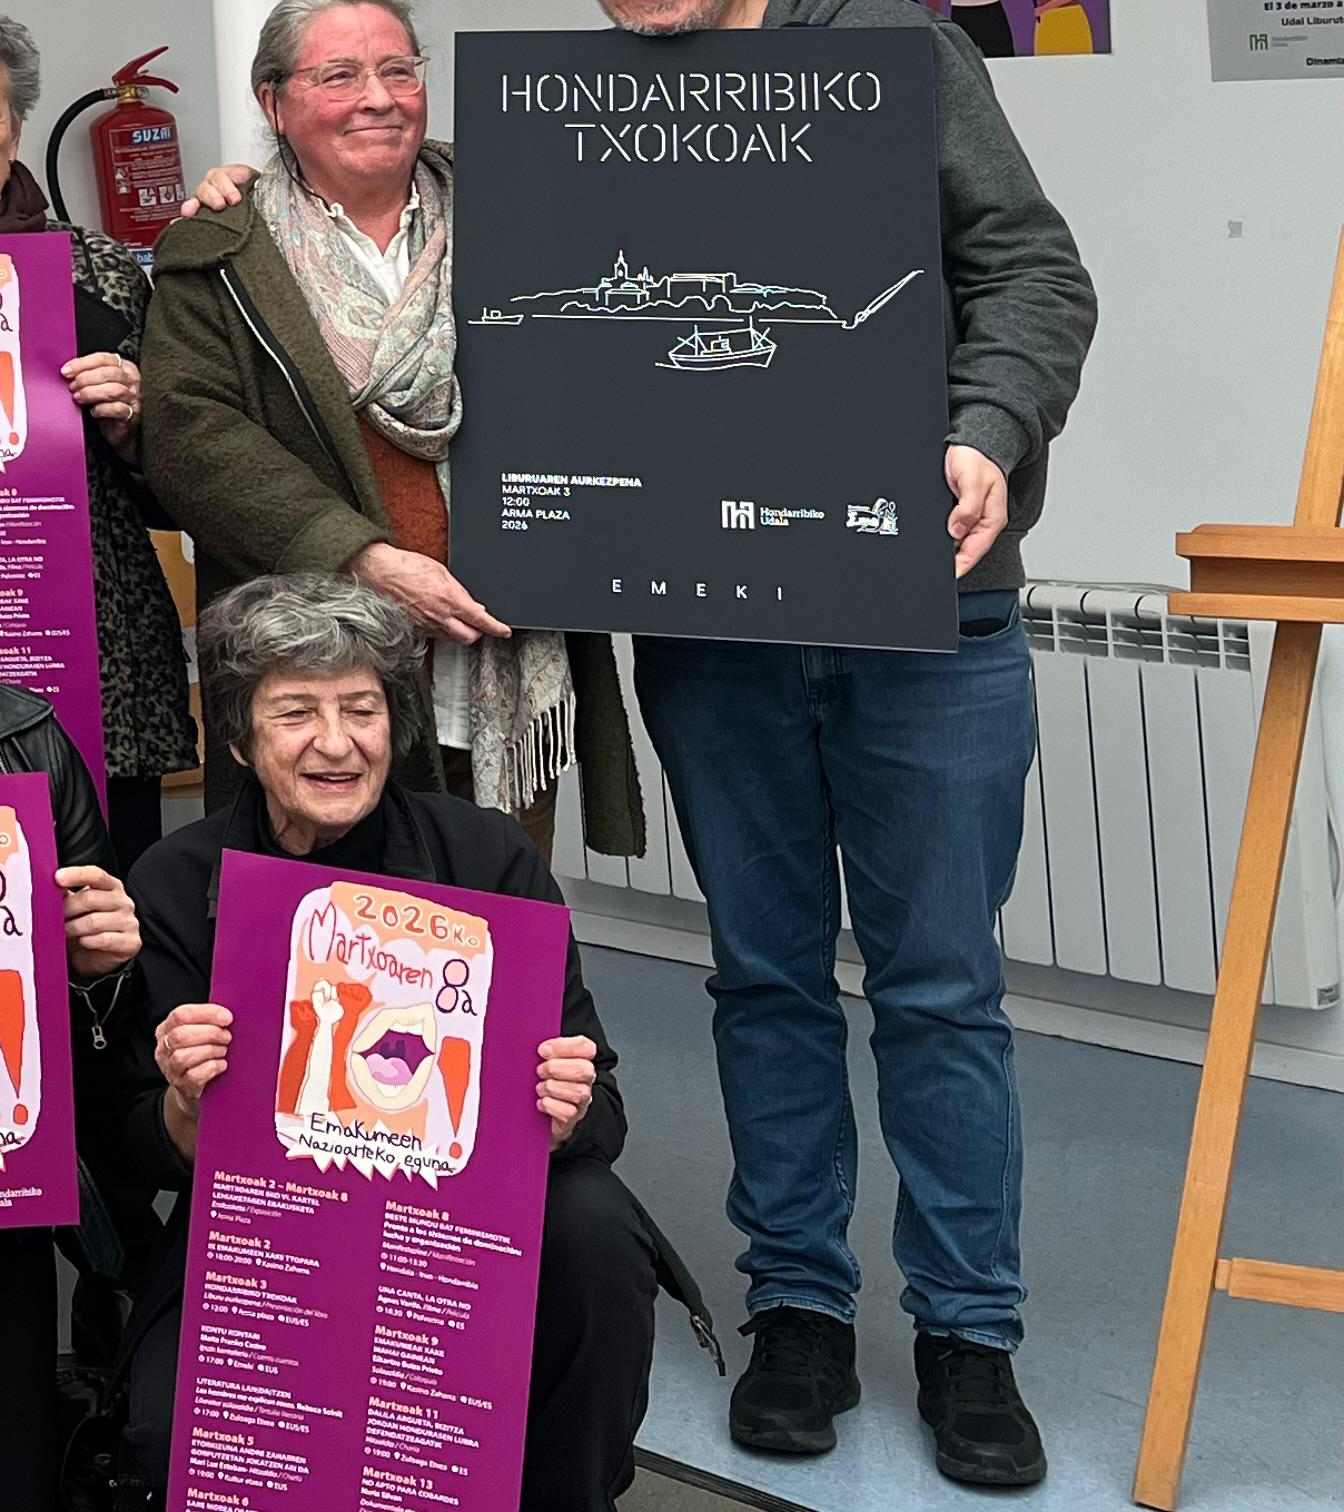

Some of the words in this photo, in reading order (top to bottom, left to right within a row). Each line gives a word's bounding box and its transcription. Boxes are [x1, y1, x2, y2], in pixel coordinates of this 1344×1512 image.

[1300, 0, 1334, 10] marzo
[502, 71, 882, 113] HONDARRIBIKO
[564, 122, 813, 163] TXOKOAK
[502, 484, 561, 496] MARTXOAK
[563, 486, 571, 497] 3
[570, 475, 643, 488] AURKEZPENA
[502, 496, 530, 507] 12:00
[501, 508, 534, 518] ARMA
[535, 509, 571, 520] PLAZA
[760, 506, 826, 521] Hondarribiko
[760, 516, 790, 527] Udala
[501, 520, 529, 531] 2026
[308, 900, 434, 990] Martxoaren
[403, 1155, 454, 1173] eguna
[214, 1170, 267, 1188] Martxoak
[268, 1179, 276, 1190] 2
[285, 1181, 339, 1201] Martxoak
[340, 1192, 349, 1202] 8
[385, 1200, 440, 1219] Martxoak
[209, 1230, 262, 1249] Martxoak
[263, 1239, 271, 1250] 2
[205, 1271, 258, 1288] Martxoak
[259, 1279, 267, 1289] 3
[374, 1324, 429, 1345] Martxoak
[430, 1336, 439, 1346] 9
[368, 1396, 423, 1416] Martxoak
[424, 1408, 439, 1420] 11
[192, 1426, 245, 1445] Martxoak
[246, 1435, 255, 1446] 5
[362, 1466, 417, 1487] Martxoak
[419, 1478, 433, 1490] 13
[187, 1487, 240, 1505] Martxoak
[241, 1496, 250, 1507] 6
